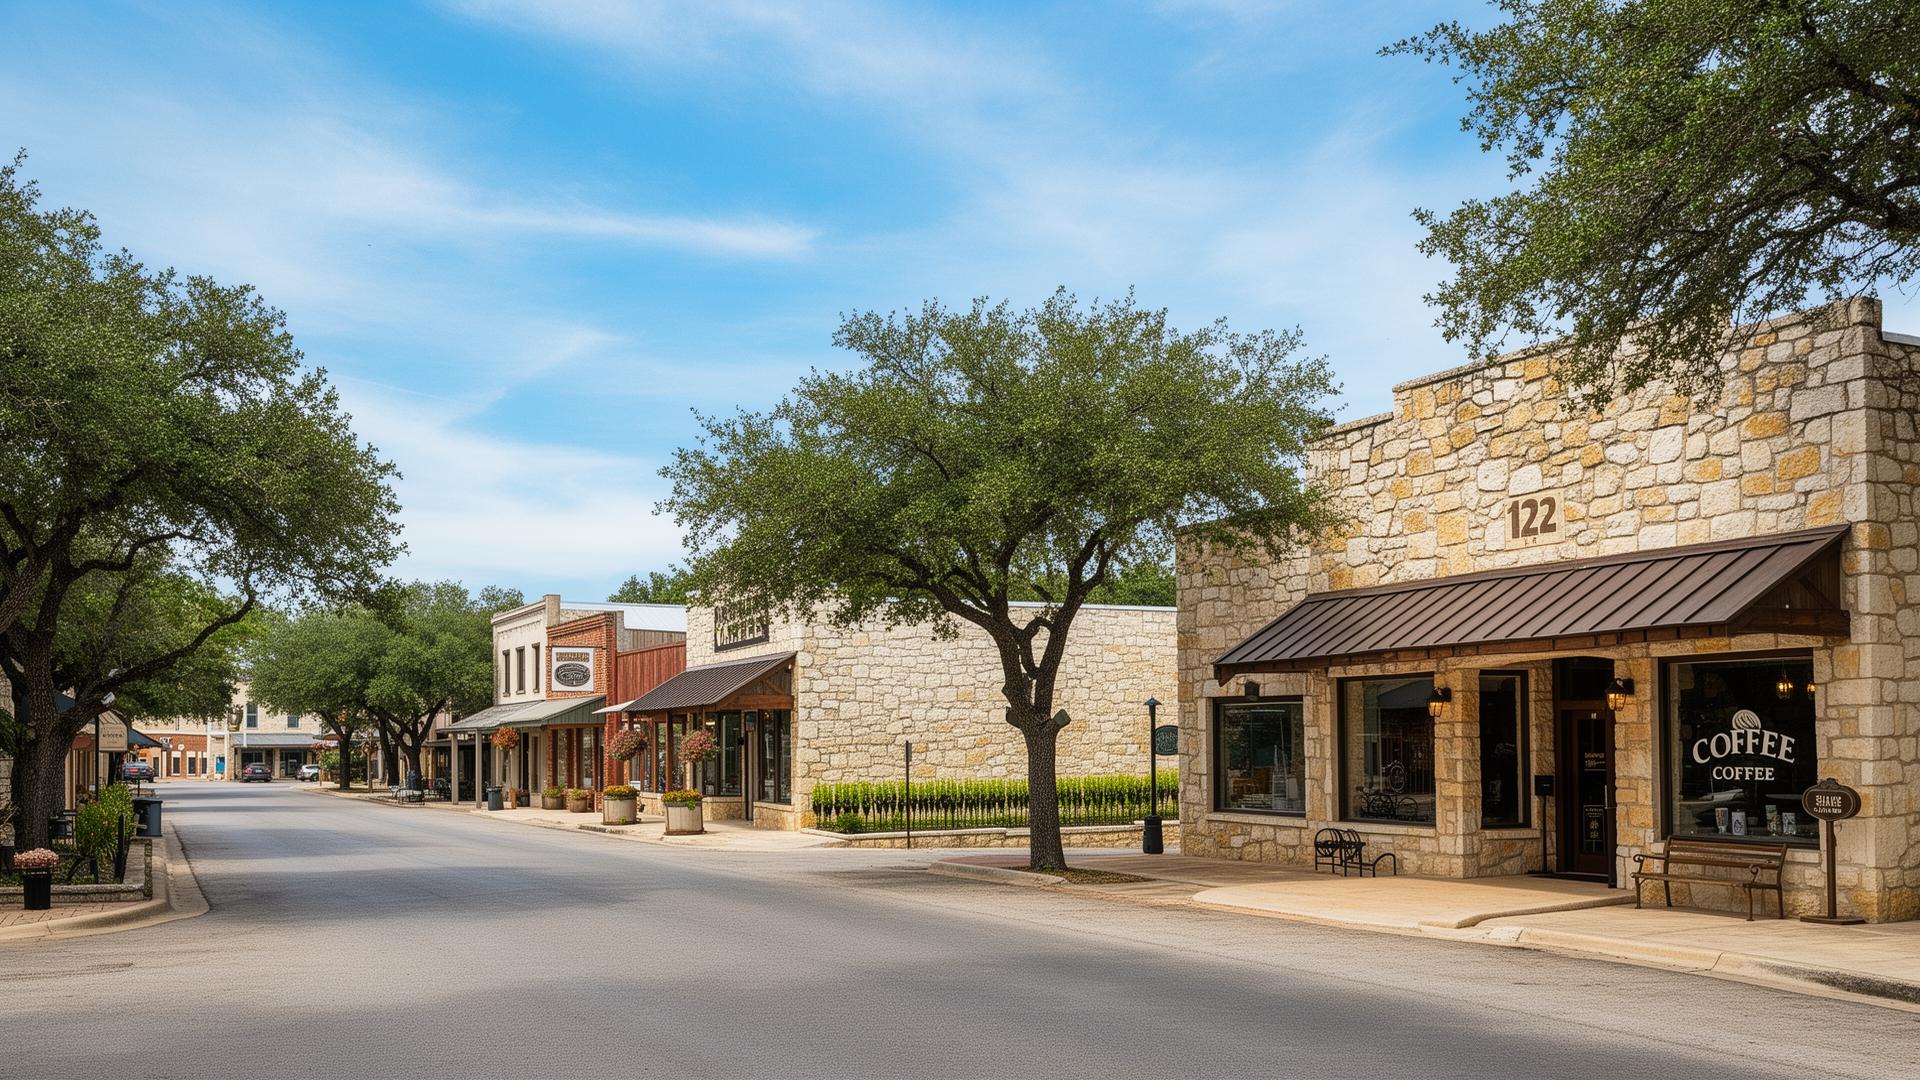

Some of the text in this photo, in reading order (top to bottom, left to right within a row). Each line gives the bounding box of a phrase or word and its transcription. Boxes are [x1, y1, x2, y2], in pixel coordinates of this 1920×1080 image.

[1507, 497, 1556, 539] 122
[1693, 729, 1795, 764] COFFEE
[1712, 766, 1775, 780] COFFEE
